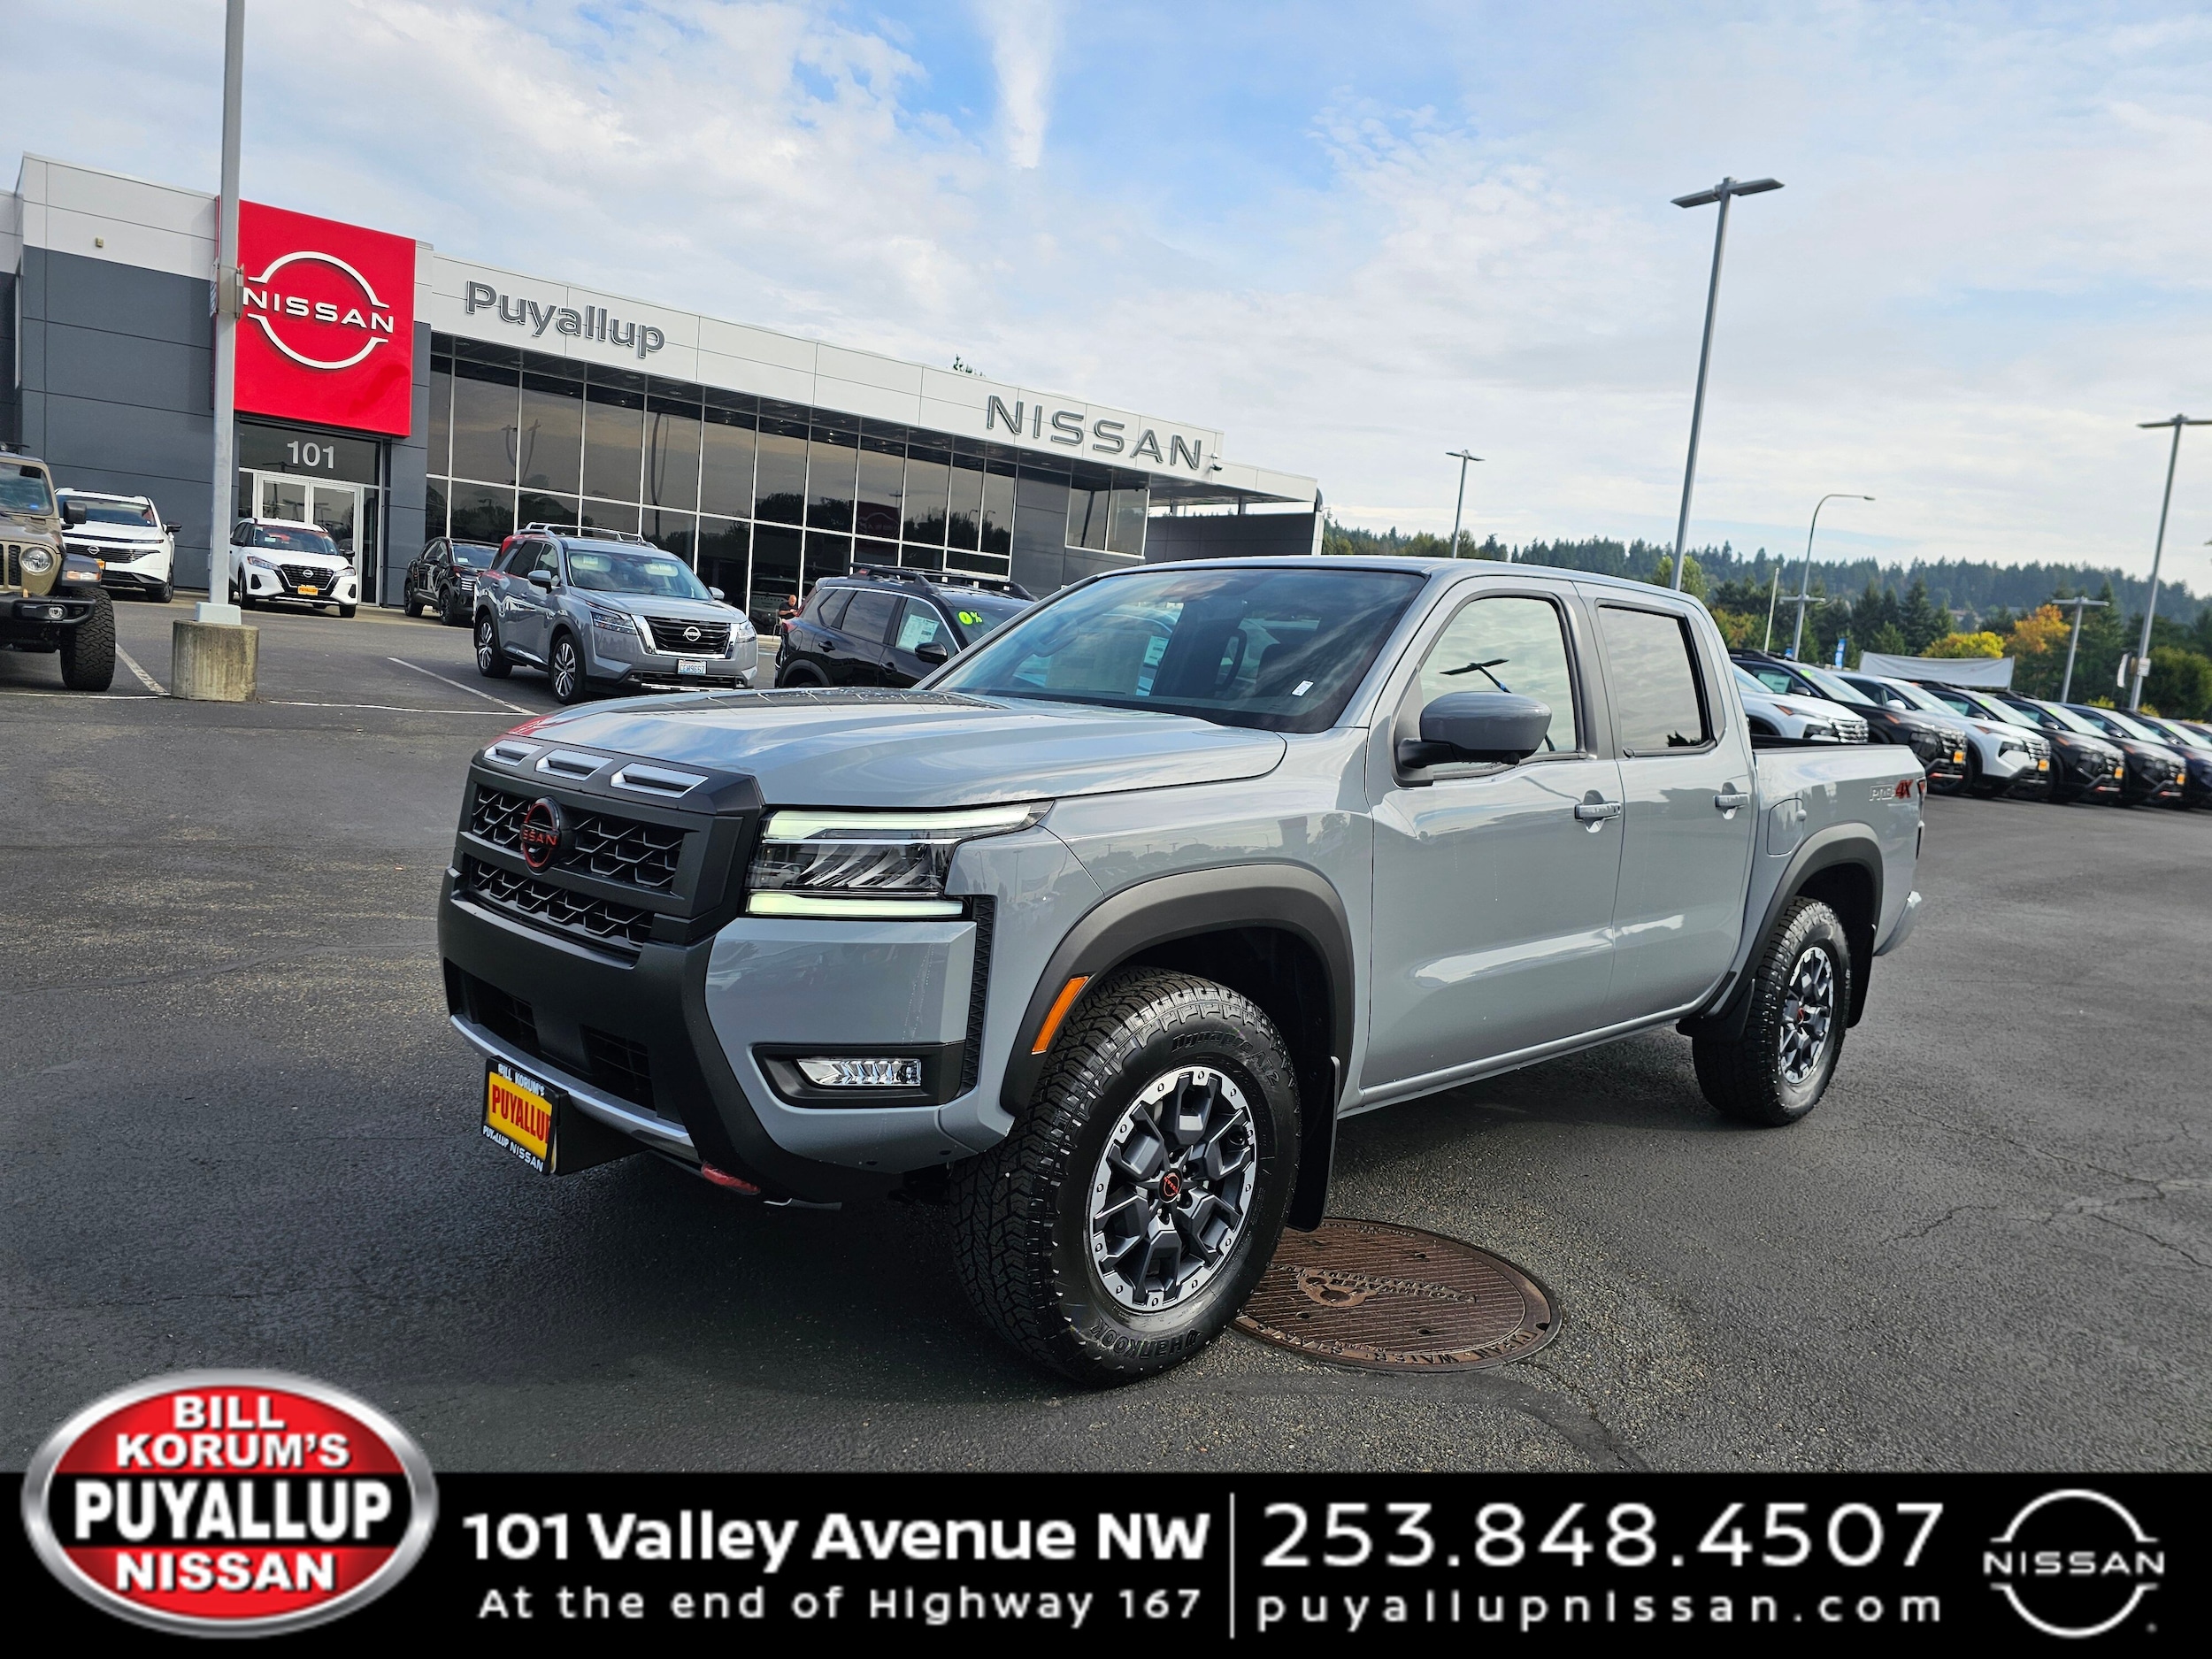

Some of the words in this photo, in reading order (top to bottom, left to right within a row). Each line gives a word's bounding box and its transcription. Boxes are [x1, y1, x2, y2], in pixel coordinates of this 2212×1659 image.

[243, 287, 395, 334] NISSAN
[465, 279, 666, 359] Puyallup
[987, 394, 1202, 471] NISSAN
[287, 440, 335, 470] 101
[958, 611, 983, 626] 0%
[1171, 1030, 1255, 1054] Dynapro
[497, 1063, 513, 1082] BILL
[514, 1071, 546, 1097] KORUM'S
[510, 1141, 544, 1173] NISSAN
[1328, 1278, 1477, 1303] STORMWATER
[1372, 1352, 1461, 1365] WATER
[1471, 1328, 1539, 1360] CLEAN
